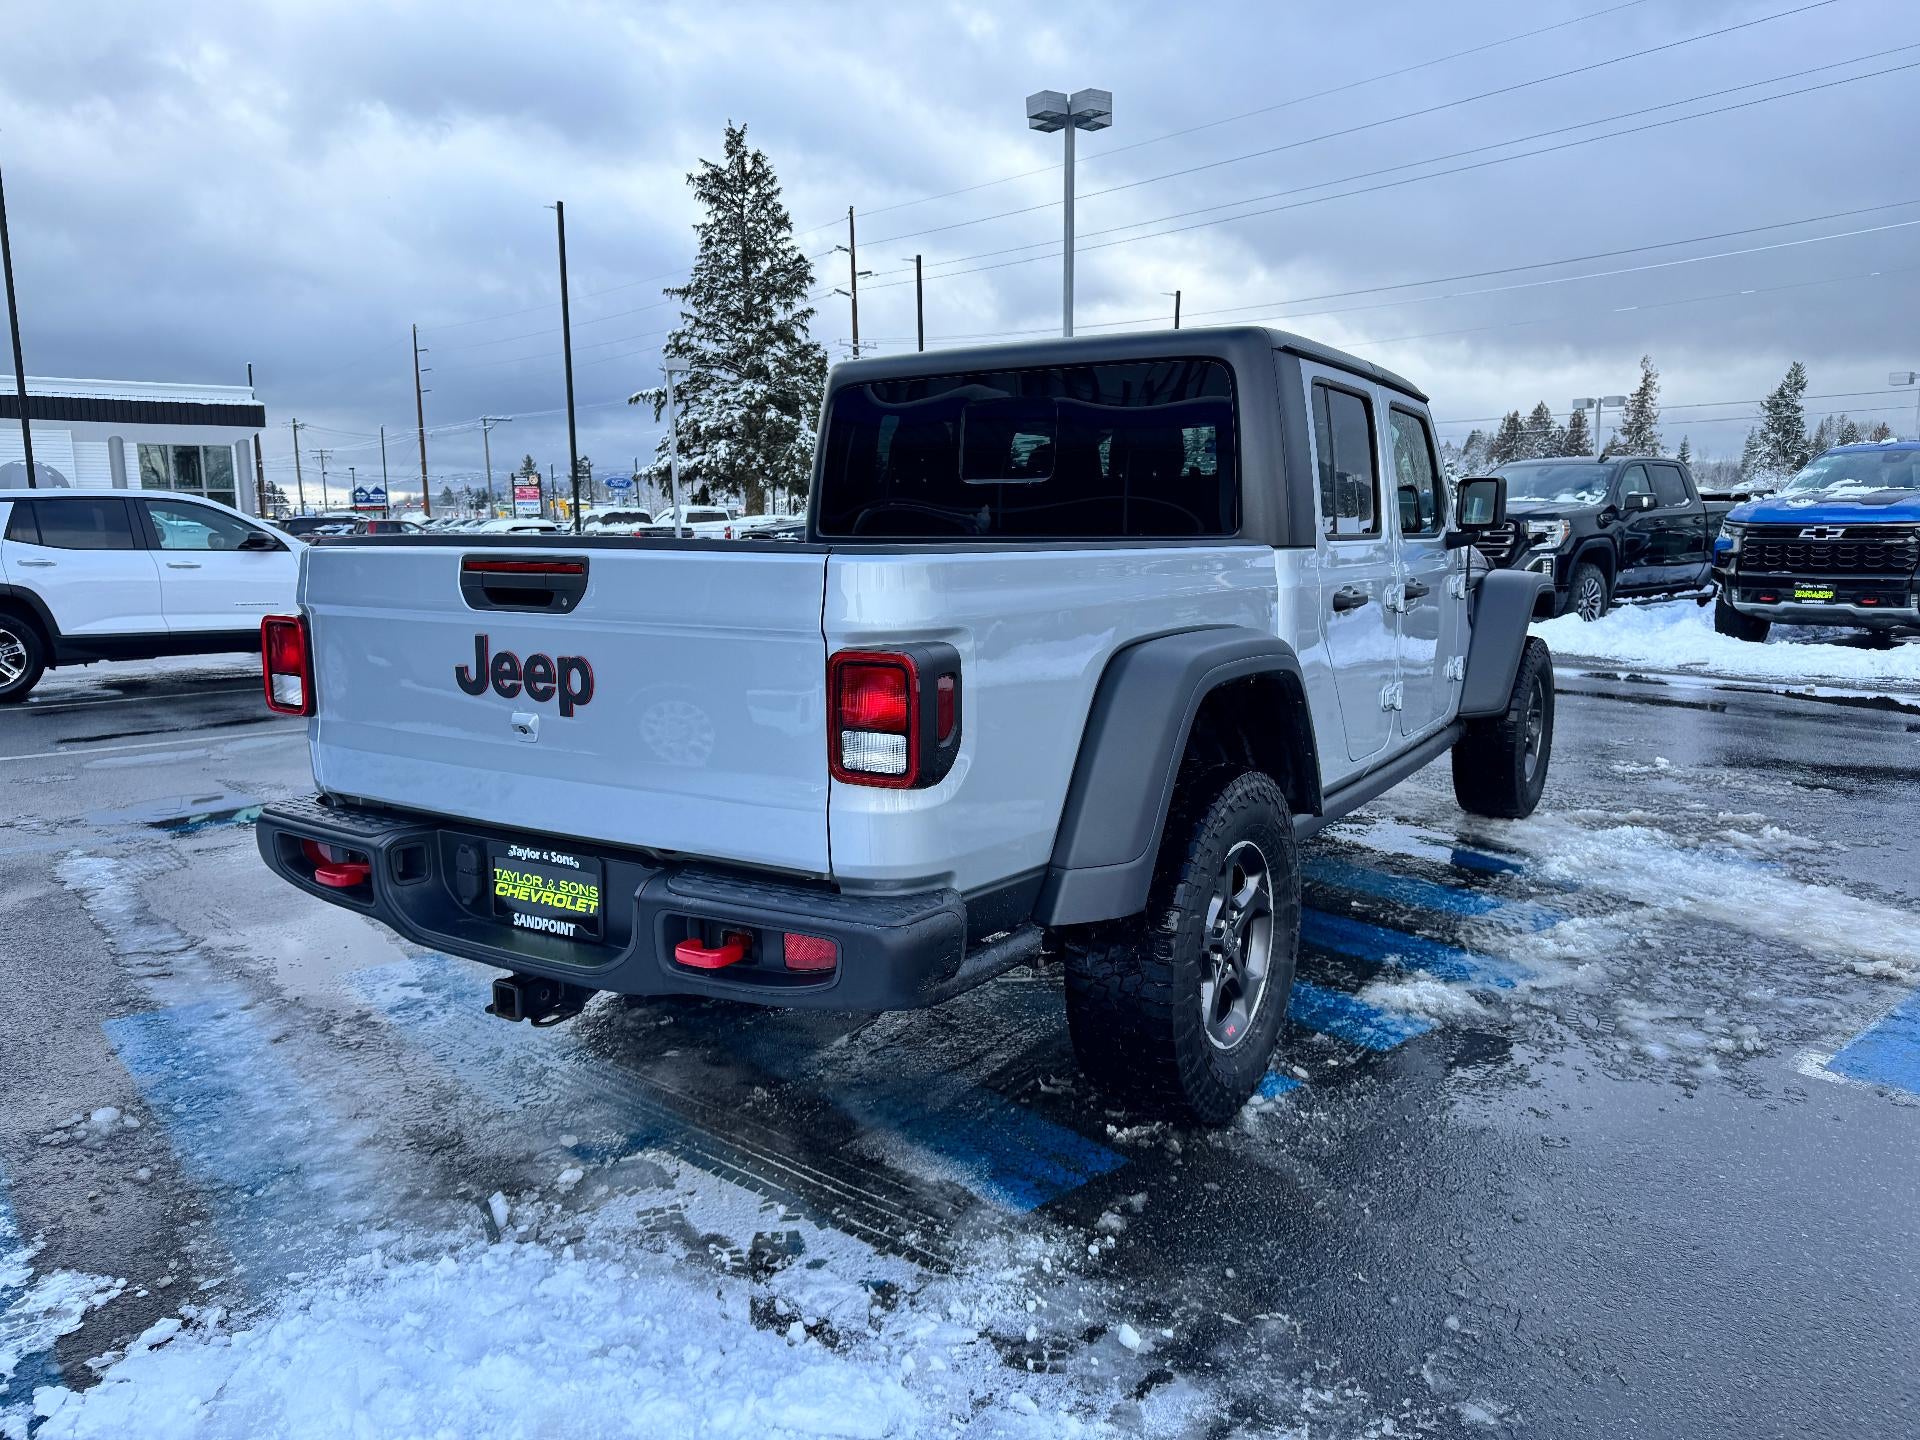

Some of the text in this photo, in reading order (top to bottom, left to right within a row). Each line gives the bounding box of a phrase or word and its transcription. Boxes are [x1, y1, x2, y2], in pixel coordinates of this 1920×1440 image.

[611, 479, 628, 487] Ford
[455, 634, 594, 717] Jeep
[510, 845, 574, 866] Taylor & Sons
[494, 868, 598, 898] TAYLOR & SONS
[495, 883, 598, 913] CHEVROLET
[513, 912, 576, 936] SANDPOINT
